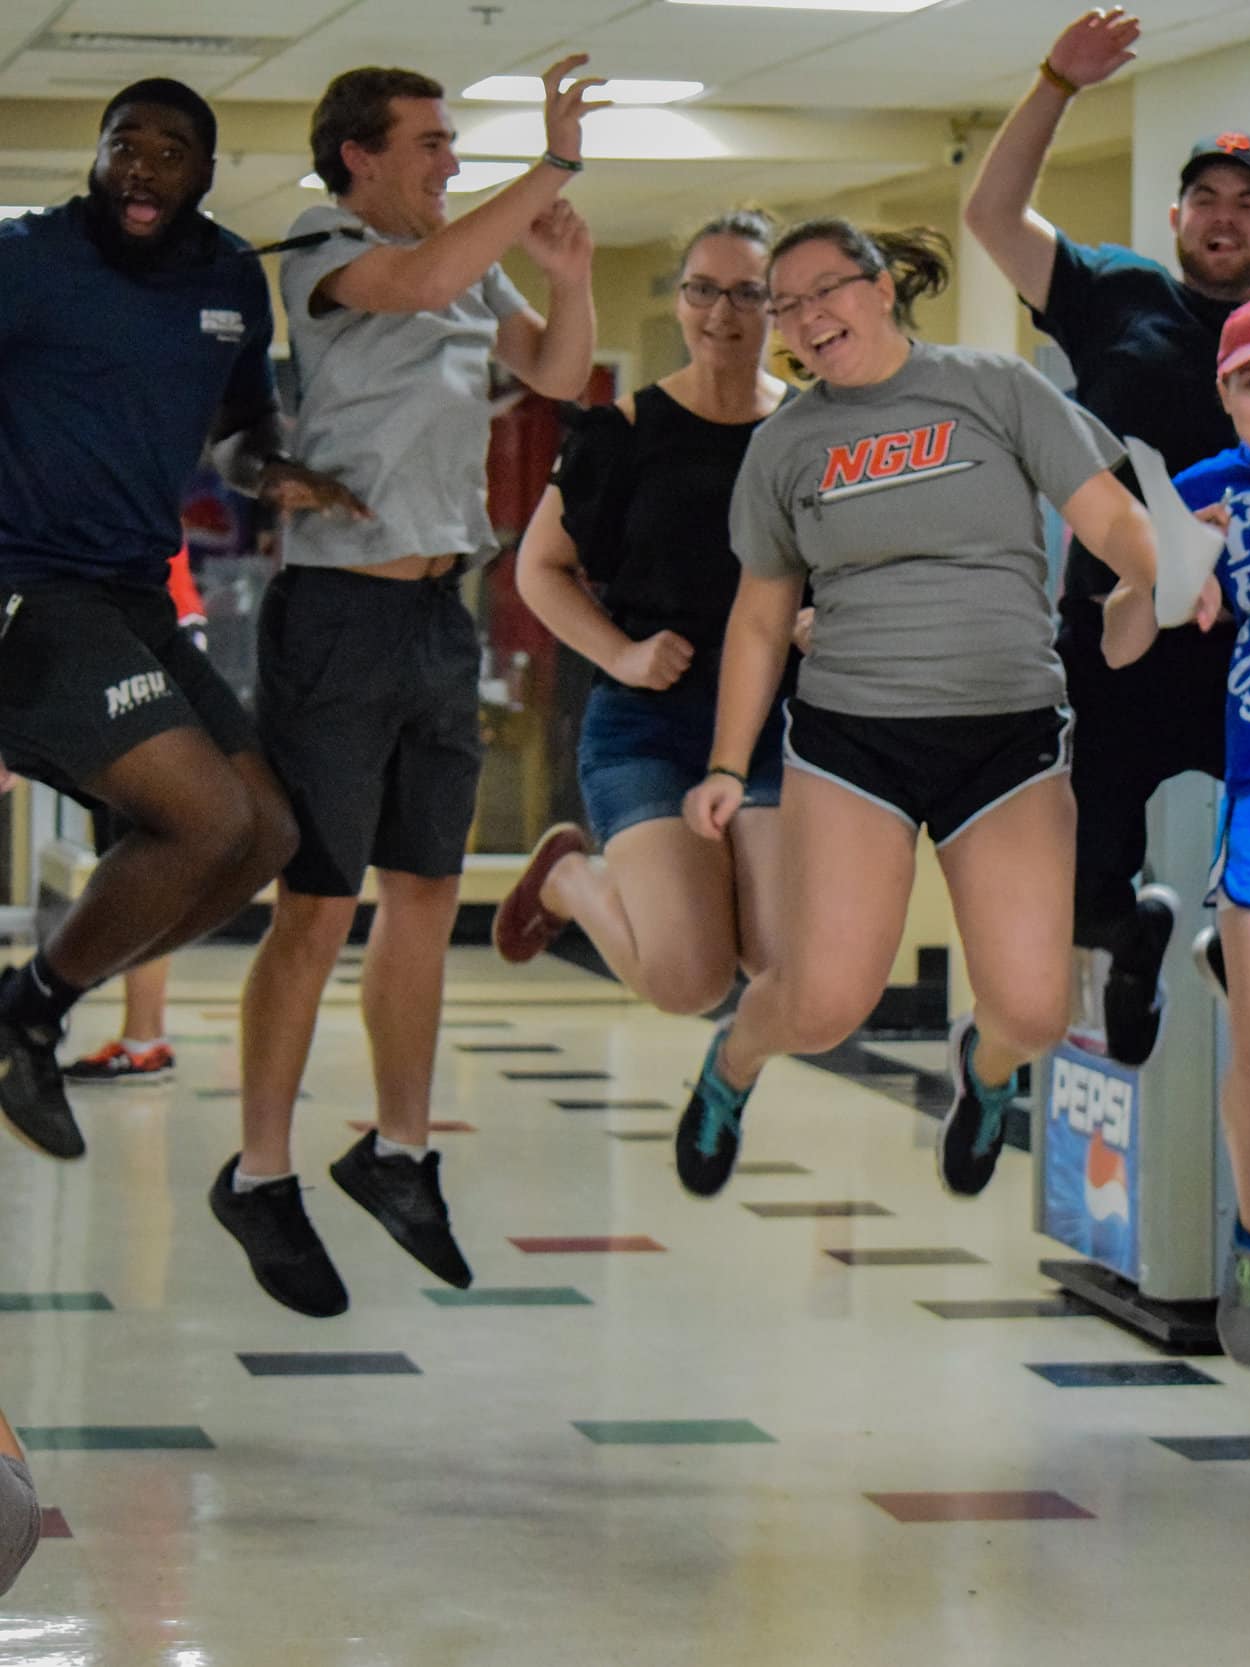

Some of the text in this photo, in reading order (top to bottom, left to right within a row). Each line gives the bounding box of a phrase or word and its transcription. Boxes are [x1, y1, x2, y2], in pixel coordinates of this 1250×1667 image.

[818, 419, 957, 491] NGU
[104, 670, 166, 713] NGU
[1051, 1056, 1133, 1150] PEPSI
